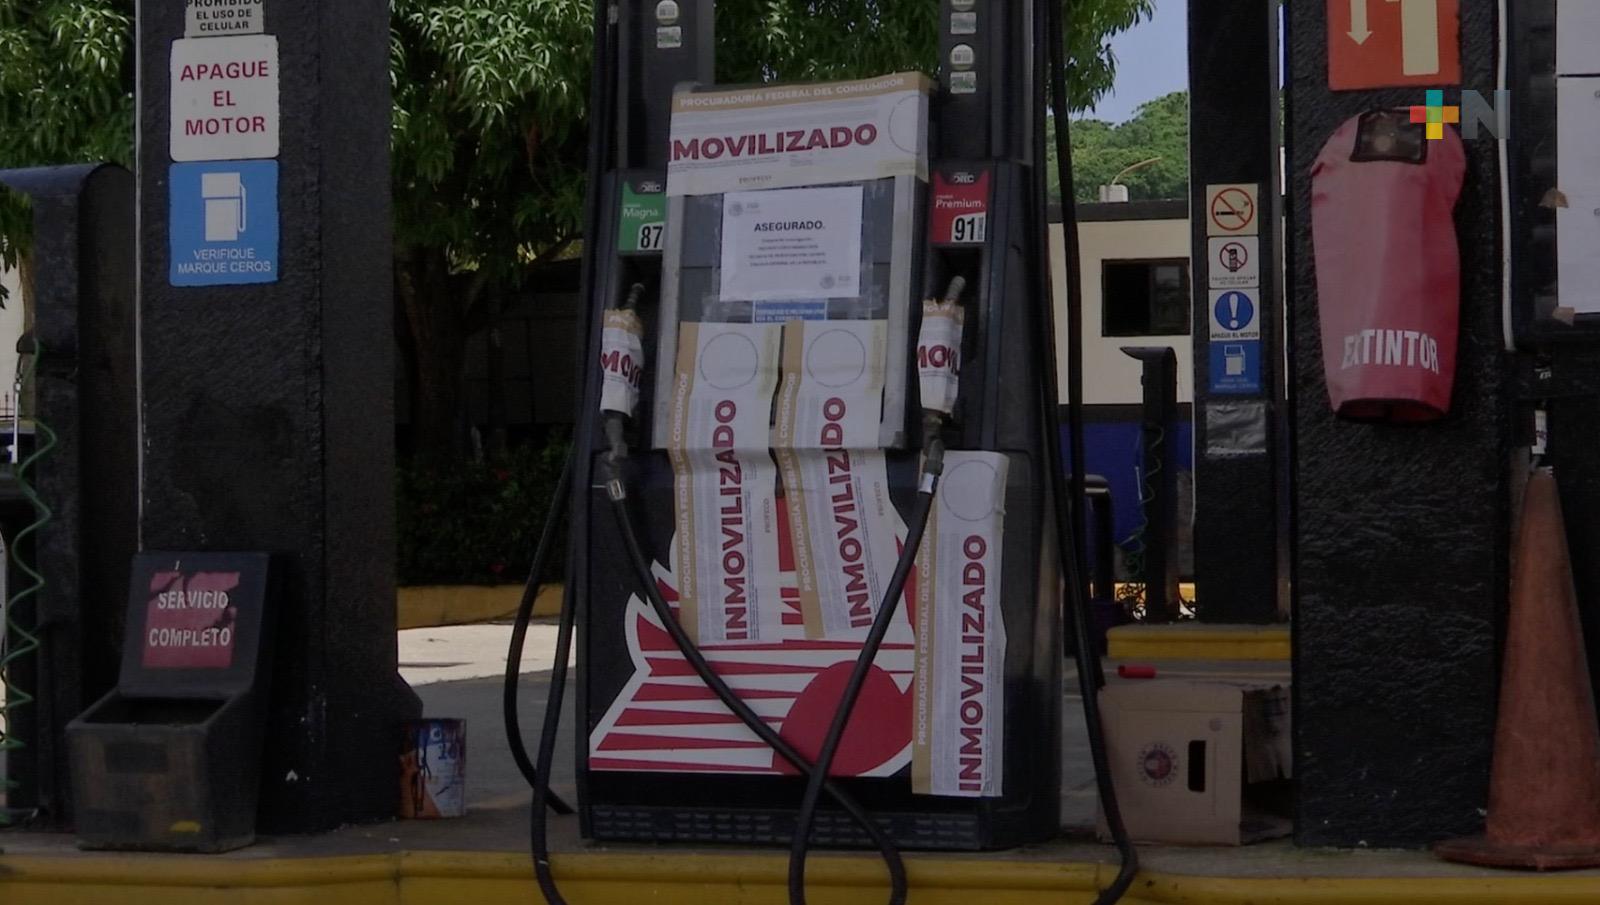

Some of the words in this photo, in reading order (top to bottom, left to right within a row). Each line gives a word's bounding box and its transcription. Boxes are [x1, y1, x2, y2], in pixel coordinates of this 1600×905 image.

[196, 11, 209, 20] EL
[212, 10, 234, 19] USO
[237, 9, 252, 18] DE
[200, 21, 249, 31] CELULAR
[180, 61, 269, 82] APAGUE
[213, 90, 236, 107] EL
[765, 87, 811, 101] FEDERAL
[813, 86, 833, 98] DEL
[836, 77, 905, 96] CONSUMIDOR
[185, 116, 266, 135] MOTOR
[623, 207, 658, 220] Magna
[754, 220, 826, 232] ASEGURADO.
[954, 217, 975, 241] 91
[640, 225, 663, 249] 87
[193, 248, 256, 260] VERIFIQUE
[177, 262, 228, 274] MARQUE
[230, 260, 271, 273] CEROS
[1342, 329, 1440, 375] EXTINTOR
[673, 373, 688, 441] CONSUMIDOR
[781, 372, 796, 439] CONSUMIDOR
[713, 399, 748, 640] INMOVILIZADO
[157, 590, 229, 609] SERVICIO
[920, 581, 931, 602] DEL
[148, 627, 231, 647] COMPLETO
[920, 604, 930, 654] FEDERAL
[959, 535, 987, 791] INMOVILIZADO
[918, 657, 929, 745] PROCURADURÍA
